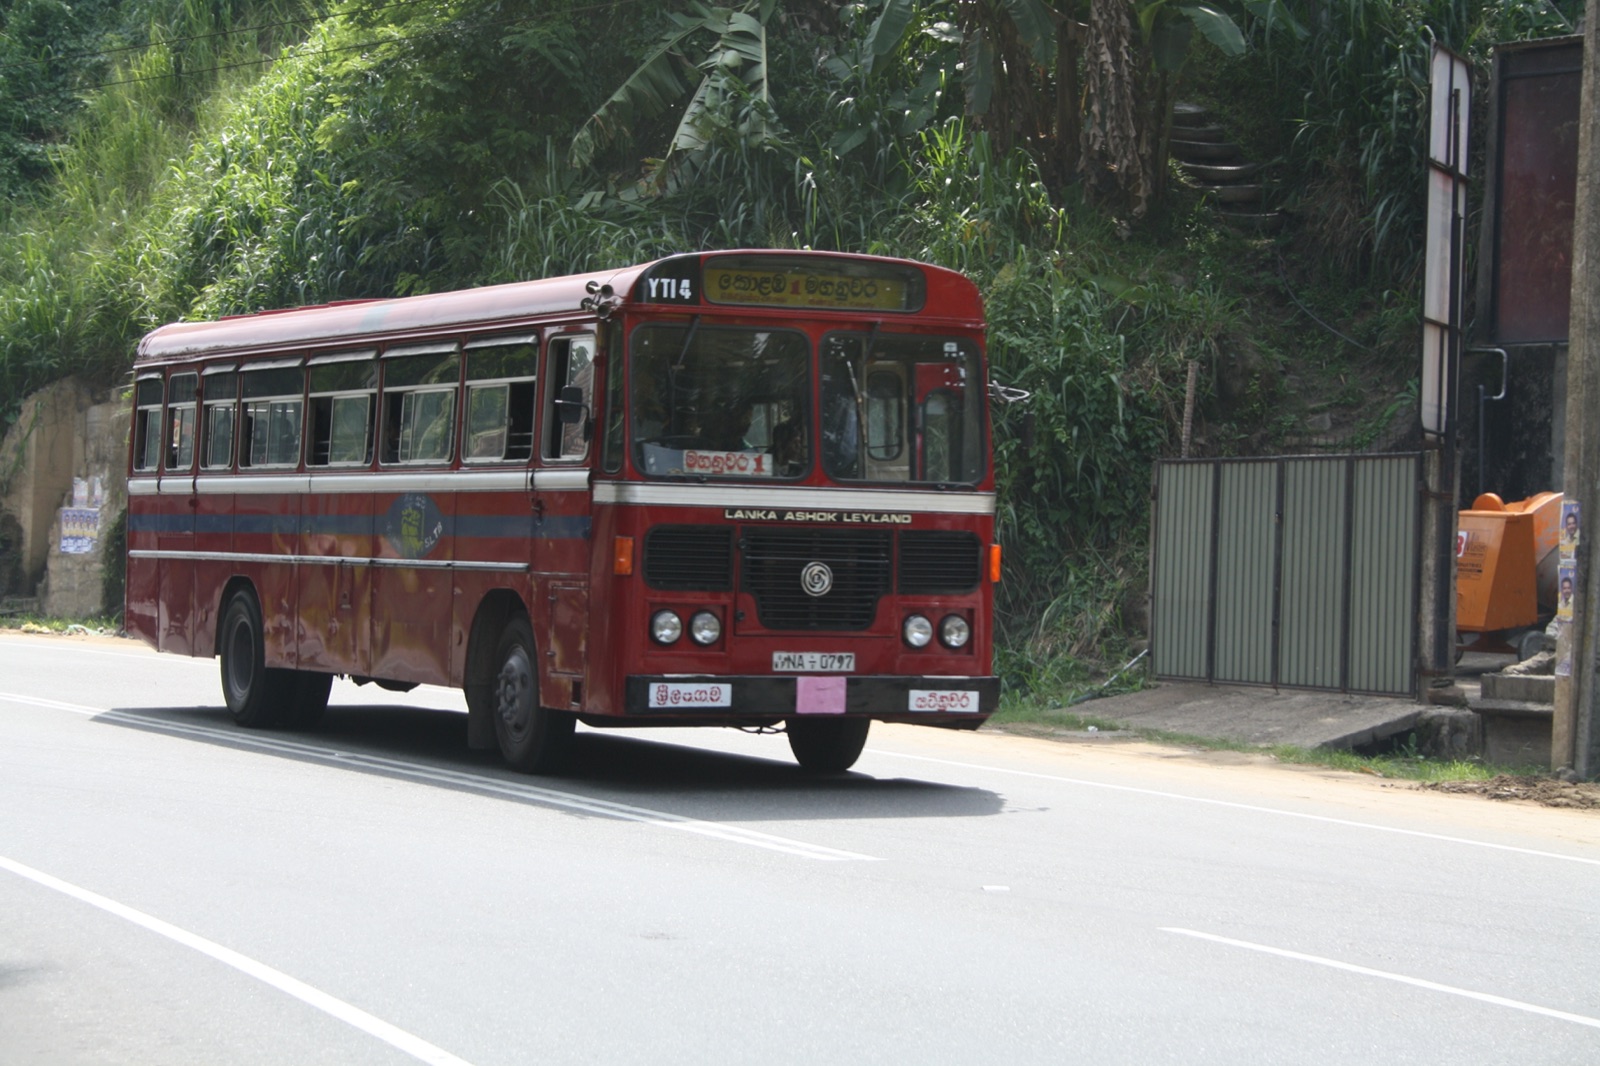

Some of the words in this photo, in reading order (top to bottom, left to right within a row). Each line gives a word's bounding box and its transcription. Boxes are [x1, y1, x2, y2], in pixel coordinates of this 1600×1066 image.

[753, 454, 765, 473] 1
[724, 508, 778, 520] LANKA
[784, 511, 837, 522] ASHOK
[842, 512, 912, 524] LEYLAND
